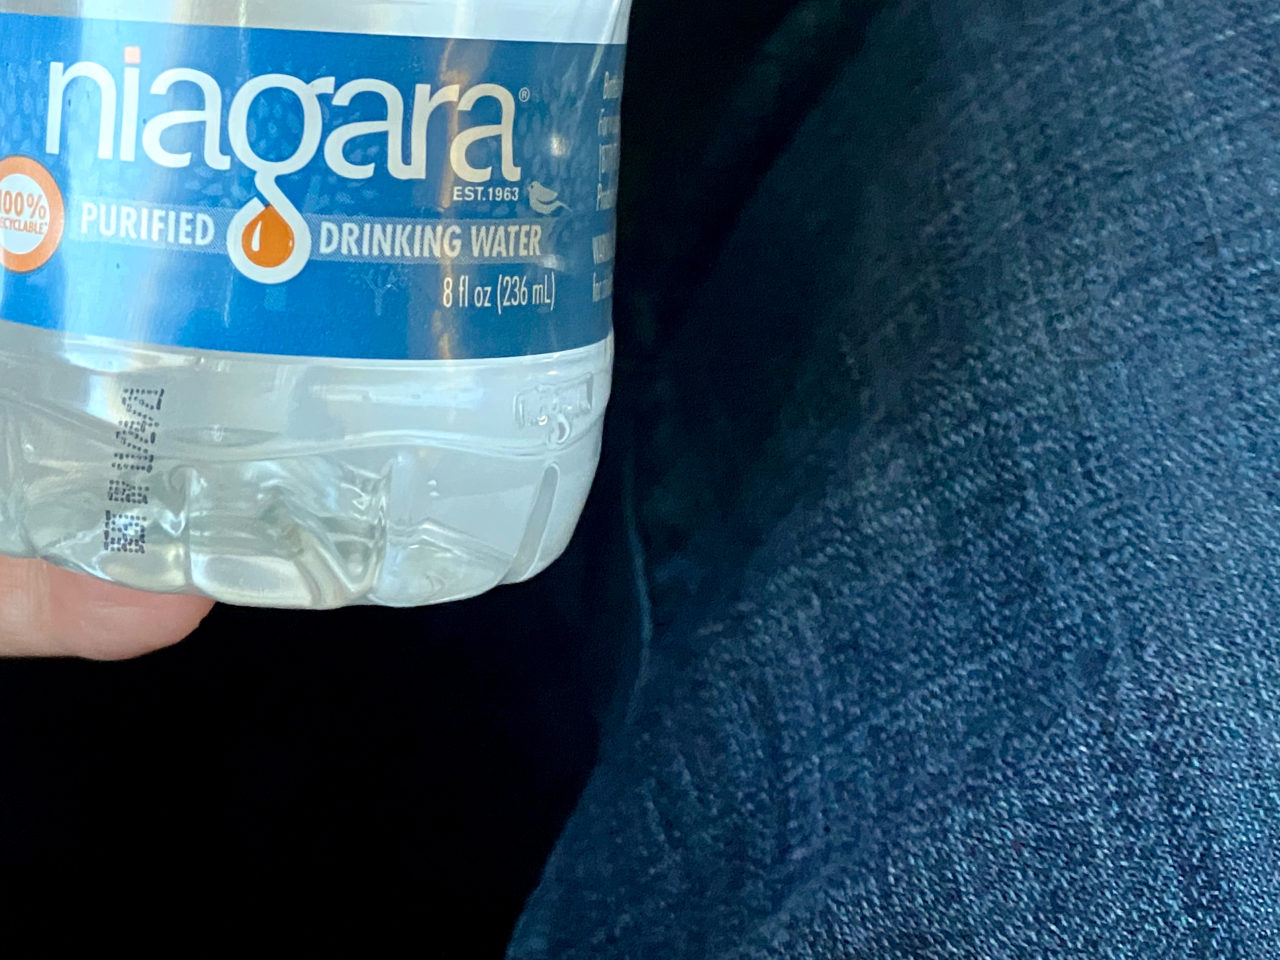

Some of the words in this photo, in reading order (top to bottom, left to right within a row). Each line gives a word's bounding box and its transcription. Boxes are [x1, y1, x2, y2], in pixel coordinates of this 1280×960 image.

[45, 46, 522, 285] niagara
[453, 185, 520, 202] EST.1963
[81, 202, 215, 246] PURIFIED
[320, 224, 463, 259] DRINKING
[470, 225, 543, 258] WATER
[442, 278, 453, 308] 8
[458, 276, 470, 308] fl
[474, 286, 492, 309] oz
[497, 276, 529, 315] (236
[532, 276, 556, 311] mL)
